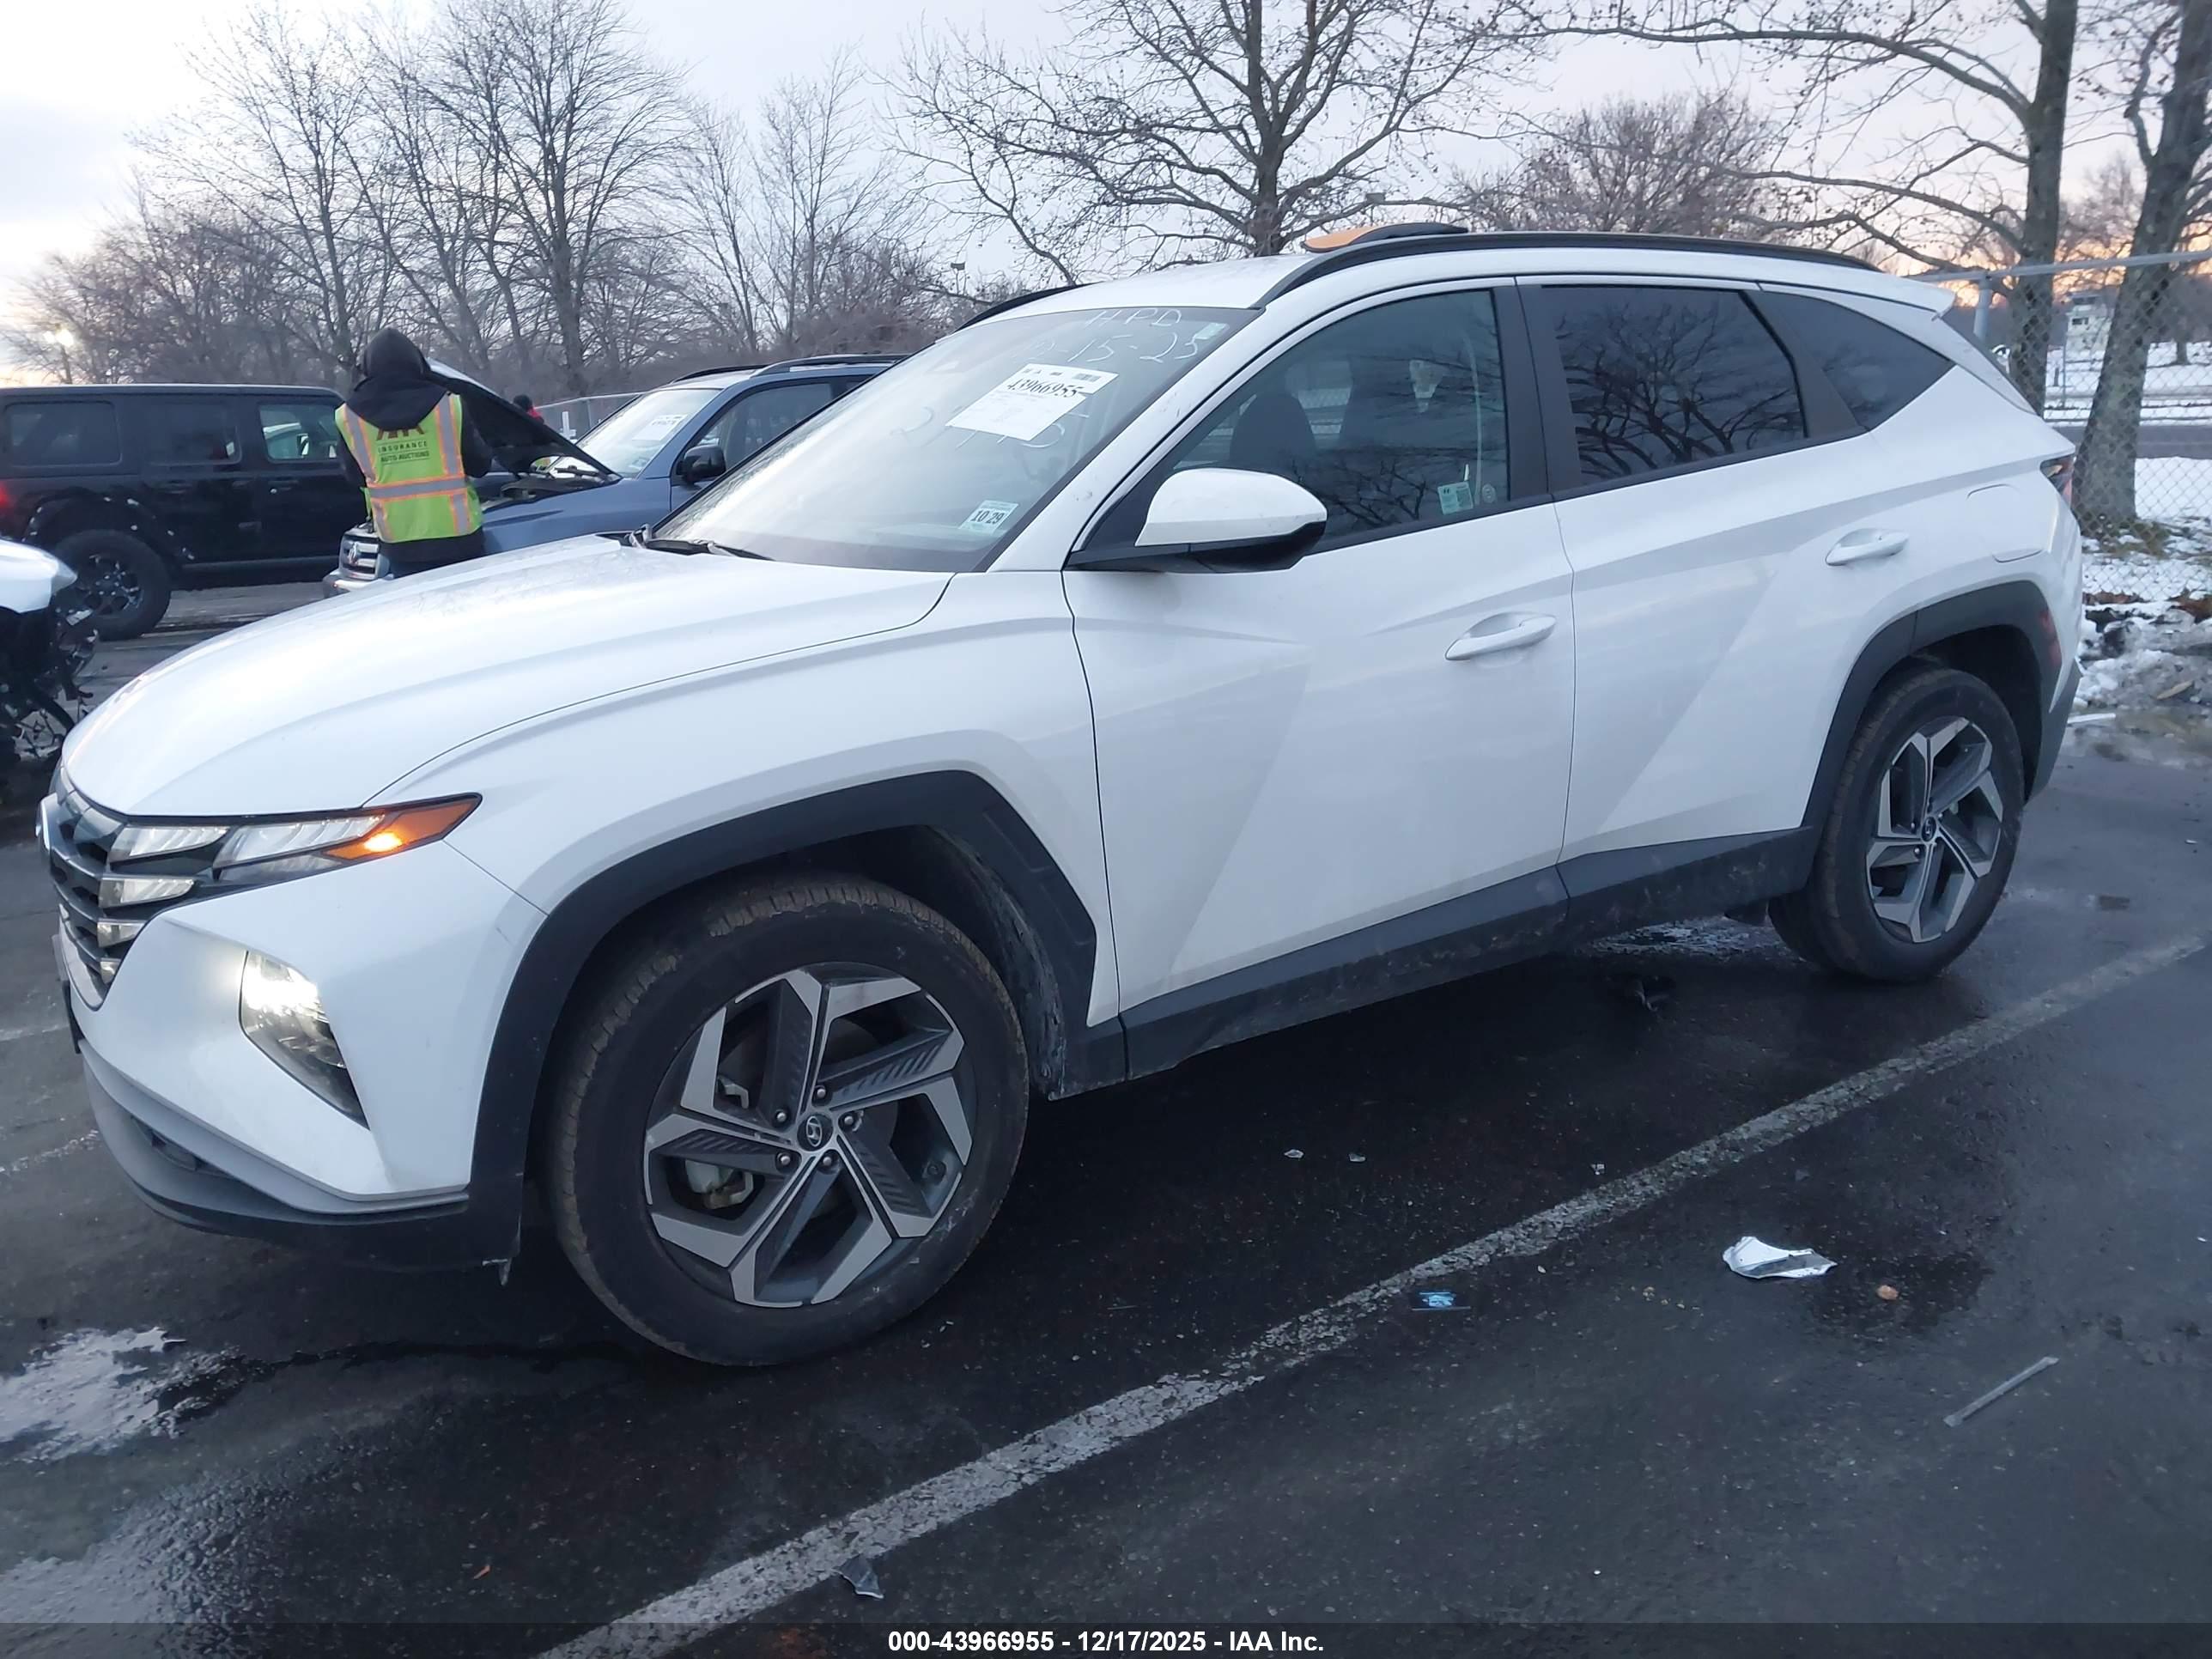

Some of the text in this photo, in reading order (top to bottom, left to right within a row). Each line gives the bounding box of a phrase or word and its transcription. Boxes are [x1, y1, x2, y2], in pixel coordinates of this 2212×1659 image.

[1006, 378, 1085, 398] 43966955
[378, 441, 427, 453] INSURANCE
[969, 509, 1006, 525] 10 29
